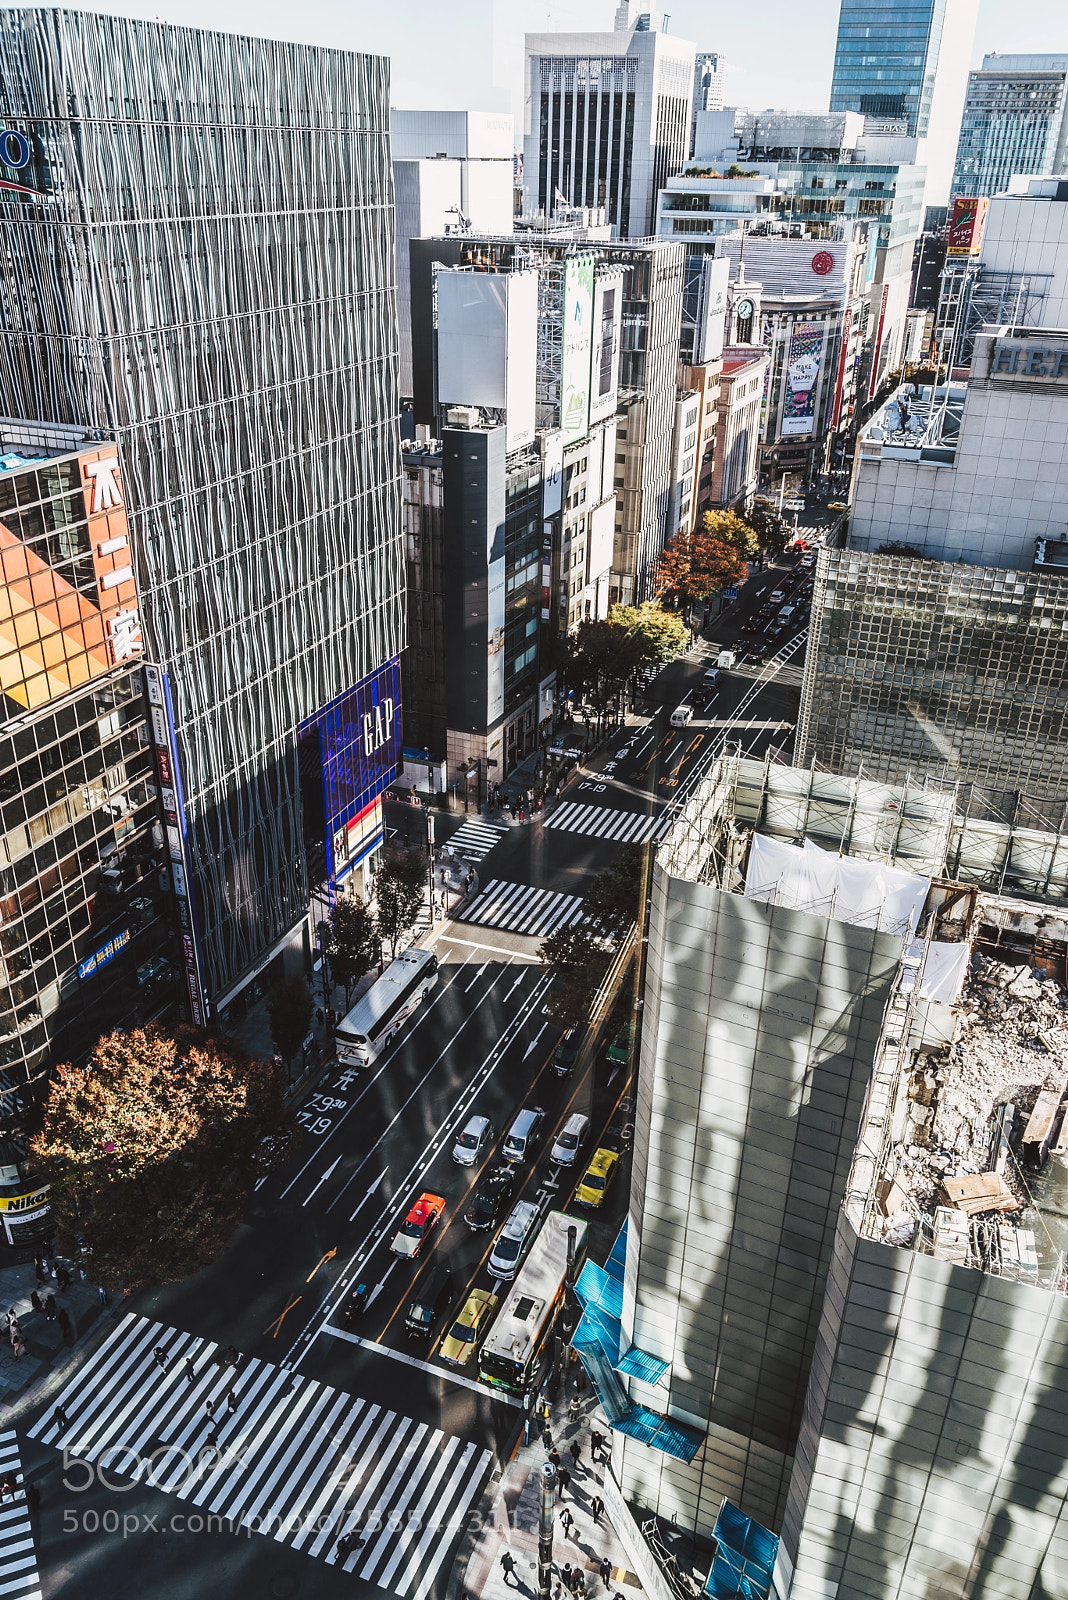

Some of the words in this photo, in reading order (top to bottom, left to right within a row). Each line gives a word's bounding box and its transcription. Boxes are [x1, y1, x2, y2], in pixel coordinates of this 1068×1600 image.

[883, 124, 905, 132] PIAS
[84, 456, 144, 665] 不二家
[363, 698, 393, 757] GAP
[578, 782, 607, 793] 17-19
[8, 1191, 47, 1211] Niko
